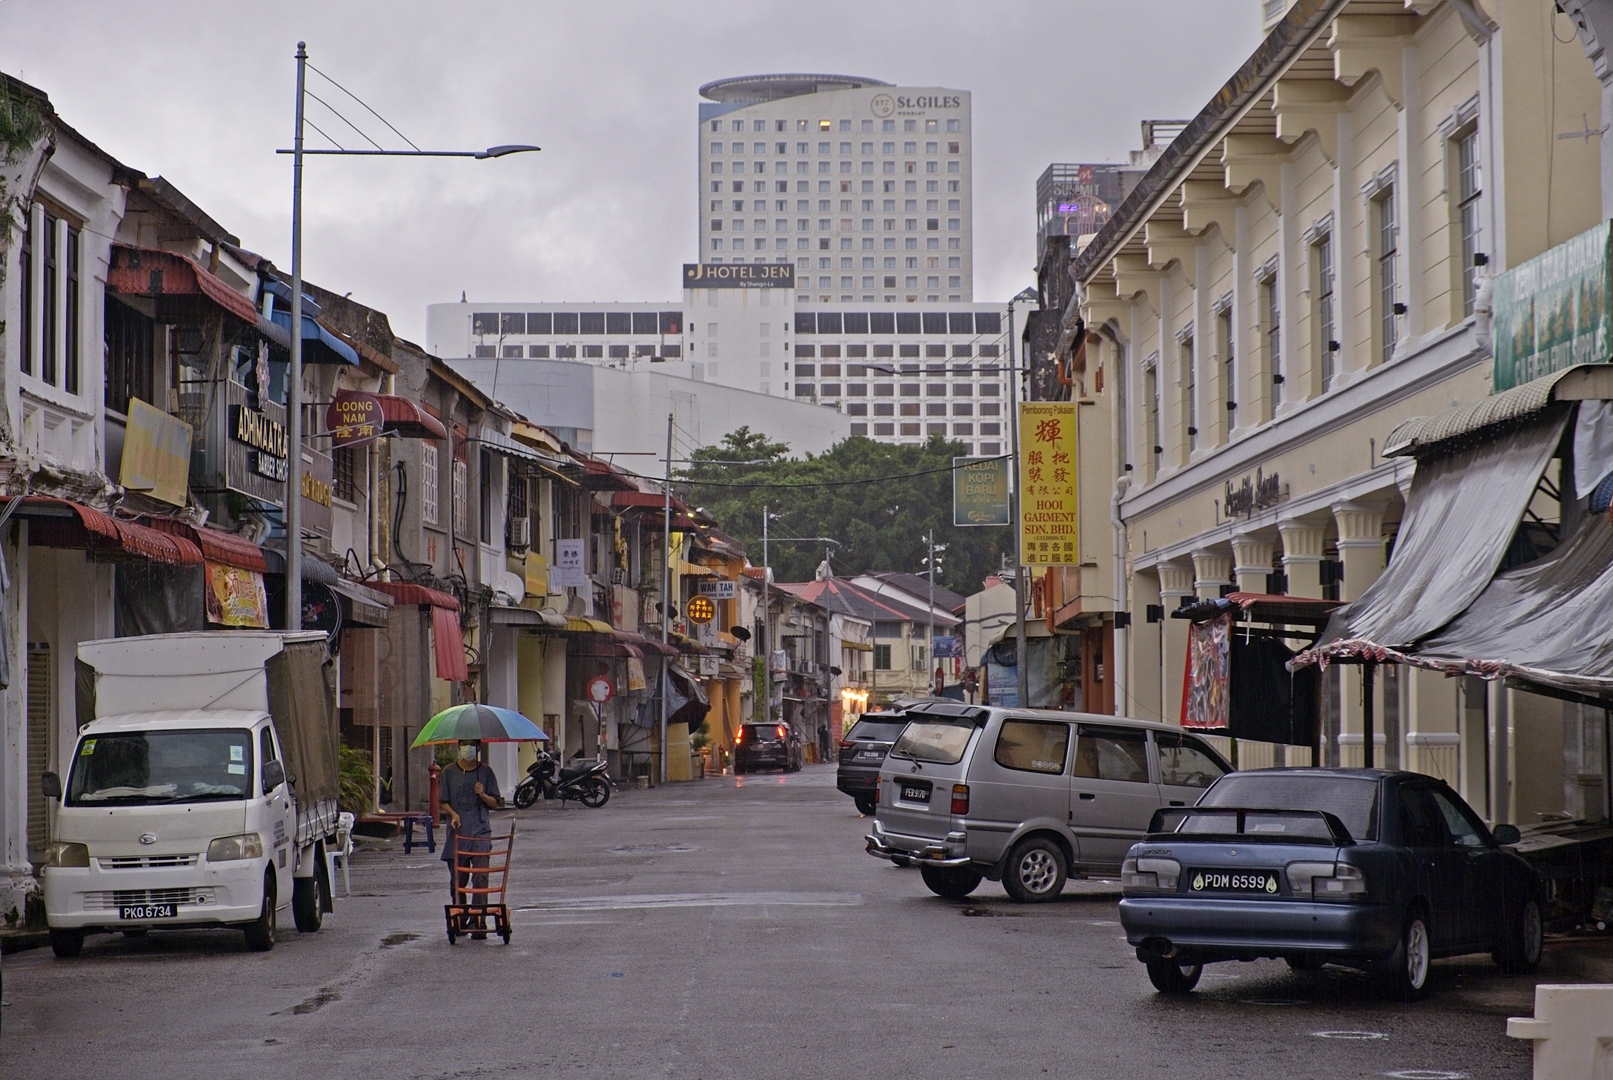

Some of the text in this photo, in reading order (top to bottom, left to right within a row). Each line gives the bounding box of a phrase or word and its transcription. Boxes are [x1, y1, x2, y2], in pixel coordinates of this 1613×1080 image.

[707, 266, 790, 279] HOTEL JEN
[336, 401, 373, 412] LOONG
[1022, 405, 1075, 416] Pemborong Pakaian
[343, 413, 366, 423] NAM
[1034, 418, 1063, 450] 輝
[964, 461, 998, 471] KEDAI
[968, 473, 994, 483] KOPI
[966, 485, 997, 495] BARU
[1026, 485, 1073, 495] 有限公司
[1036, 500, 1063, 510] HOOI
[1024, 512, 1076, 522] GARMENT
[1024, 524, 1076, 535] SDN. BHD.
[1027, 553, 1073, 563] 進口服裝
[700, 582, 733, 592] WAH TAH
[1205, 874, 1265, 888] PDM 6599
[124, 905, 171, 919] PKQ 6734
